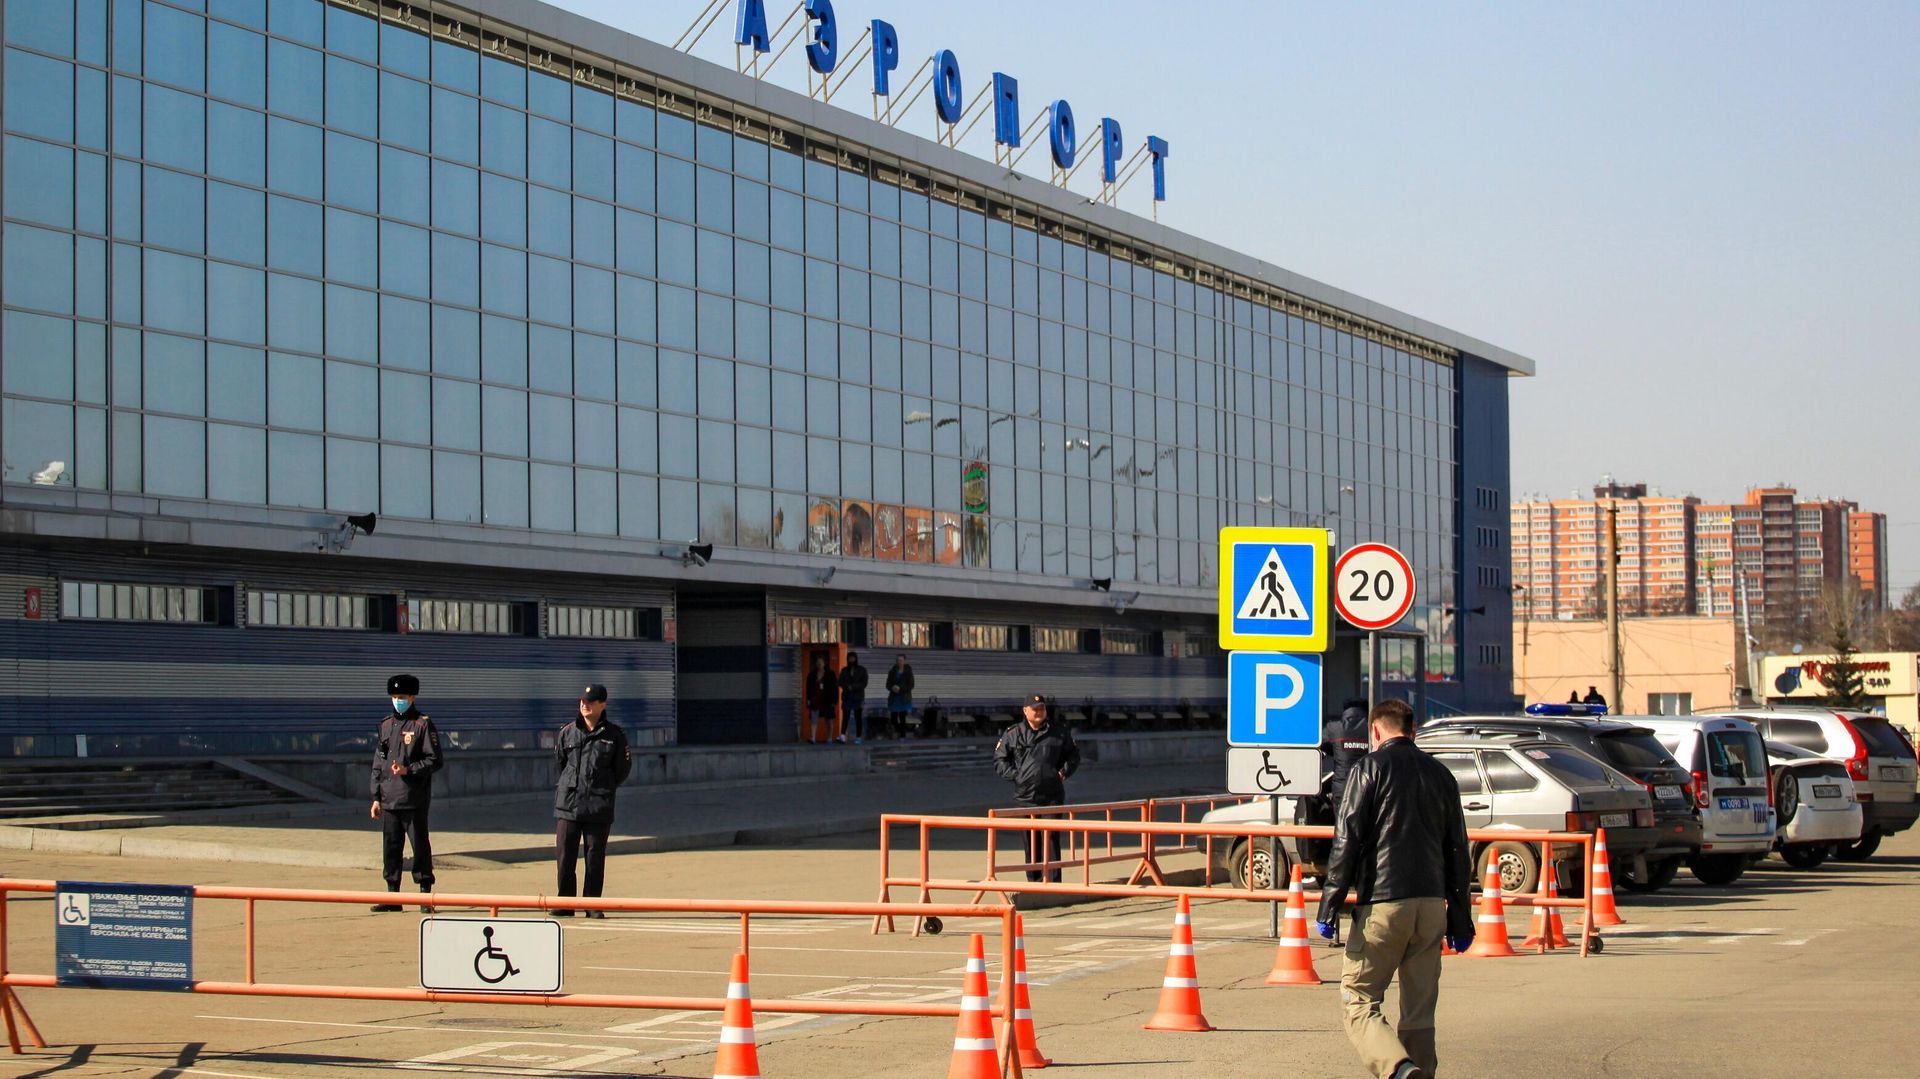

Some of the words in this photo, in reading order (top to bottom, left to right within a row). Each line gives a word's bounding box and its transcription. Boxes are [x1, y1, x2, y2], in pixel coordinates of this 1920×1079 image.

[734, 0, 1168, 201] АЭРОПОРТ
[1350, 569, 1394, 601] 20
[1255, 663, 1305, 735] P
[1343, 742, 1369, 750] ПОЛИЦИ
[114, 924, 151, 932] ОЖИДАНИЯ
[151, 926, 187, 934] ПРИБЫТИЯ
